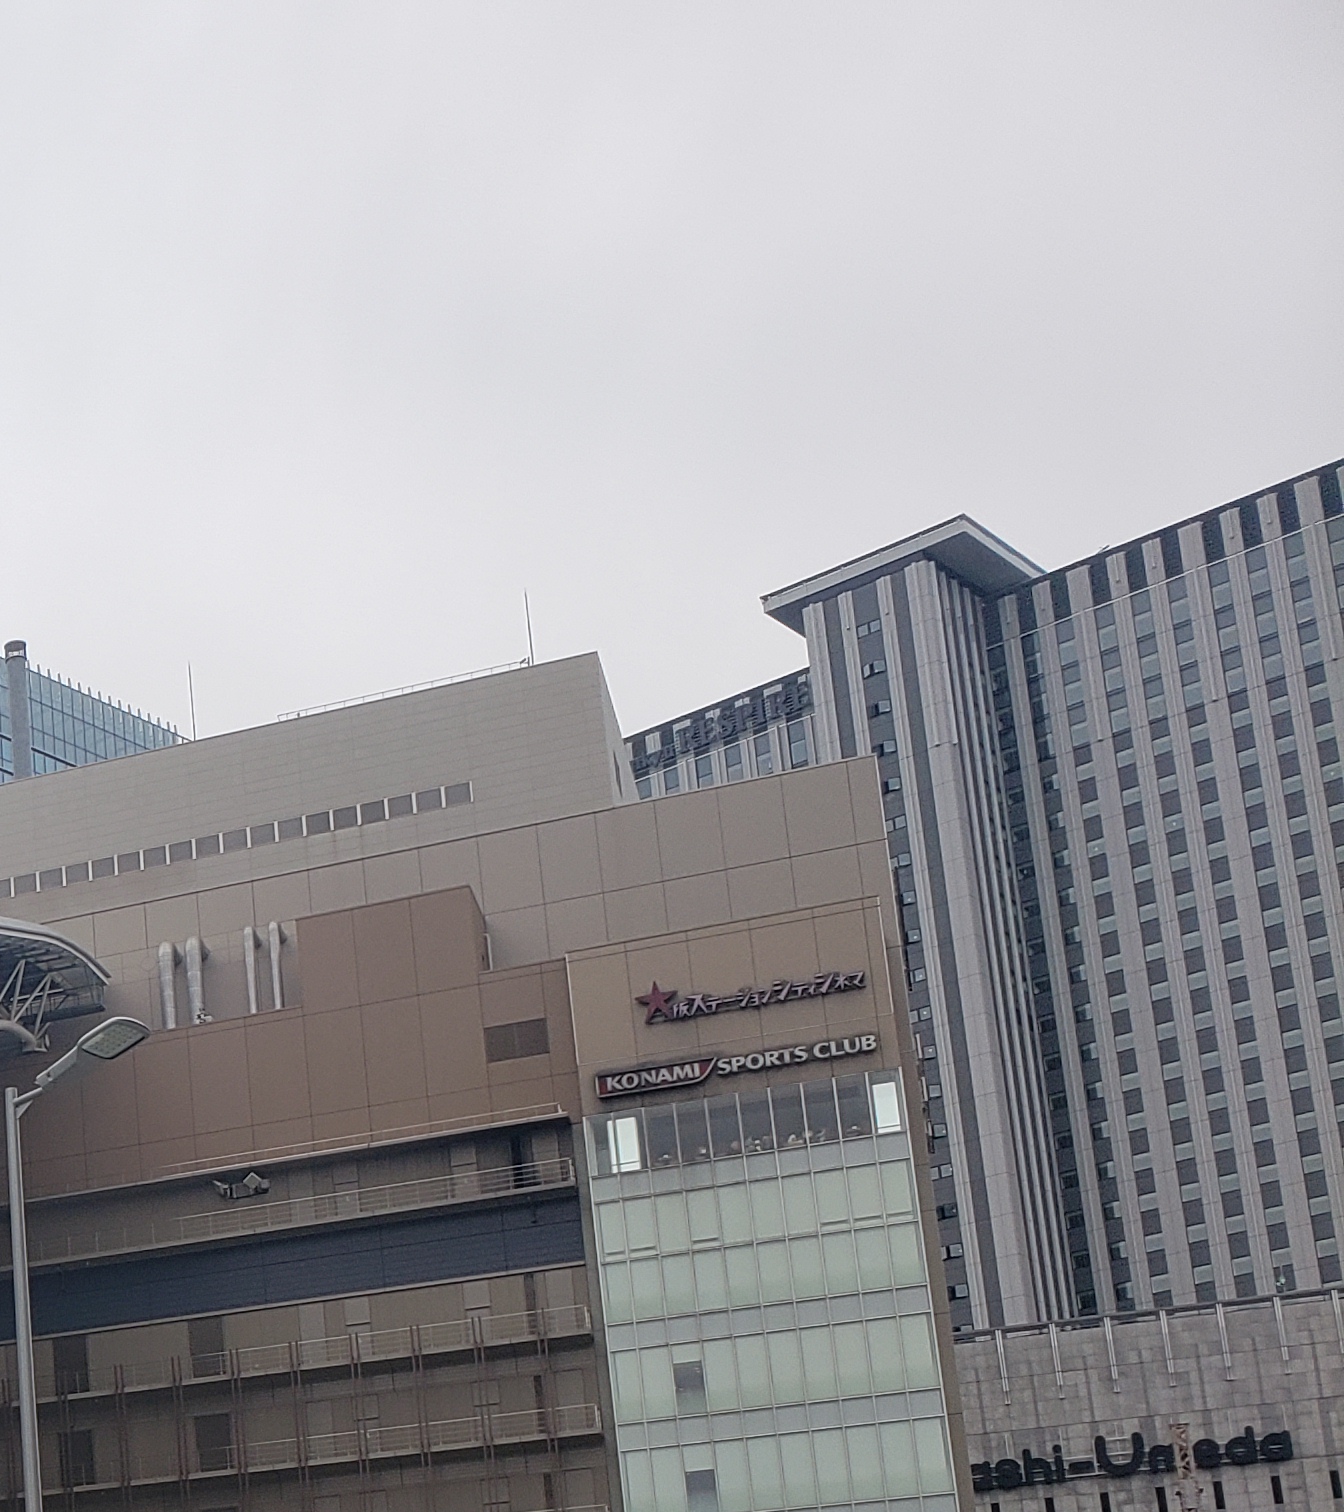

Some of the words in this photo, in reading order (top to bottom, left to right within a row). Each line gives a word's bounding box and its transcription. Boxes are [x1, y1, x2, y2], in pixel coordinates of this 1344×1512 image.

[606, 1062, 702, 1092] KONAMI
[717, 1046, 808, 1076] SPORTS
[813, 1034, 877, 1059] CLUB
